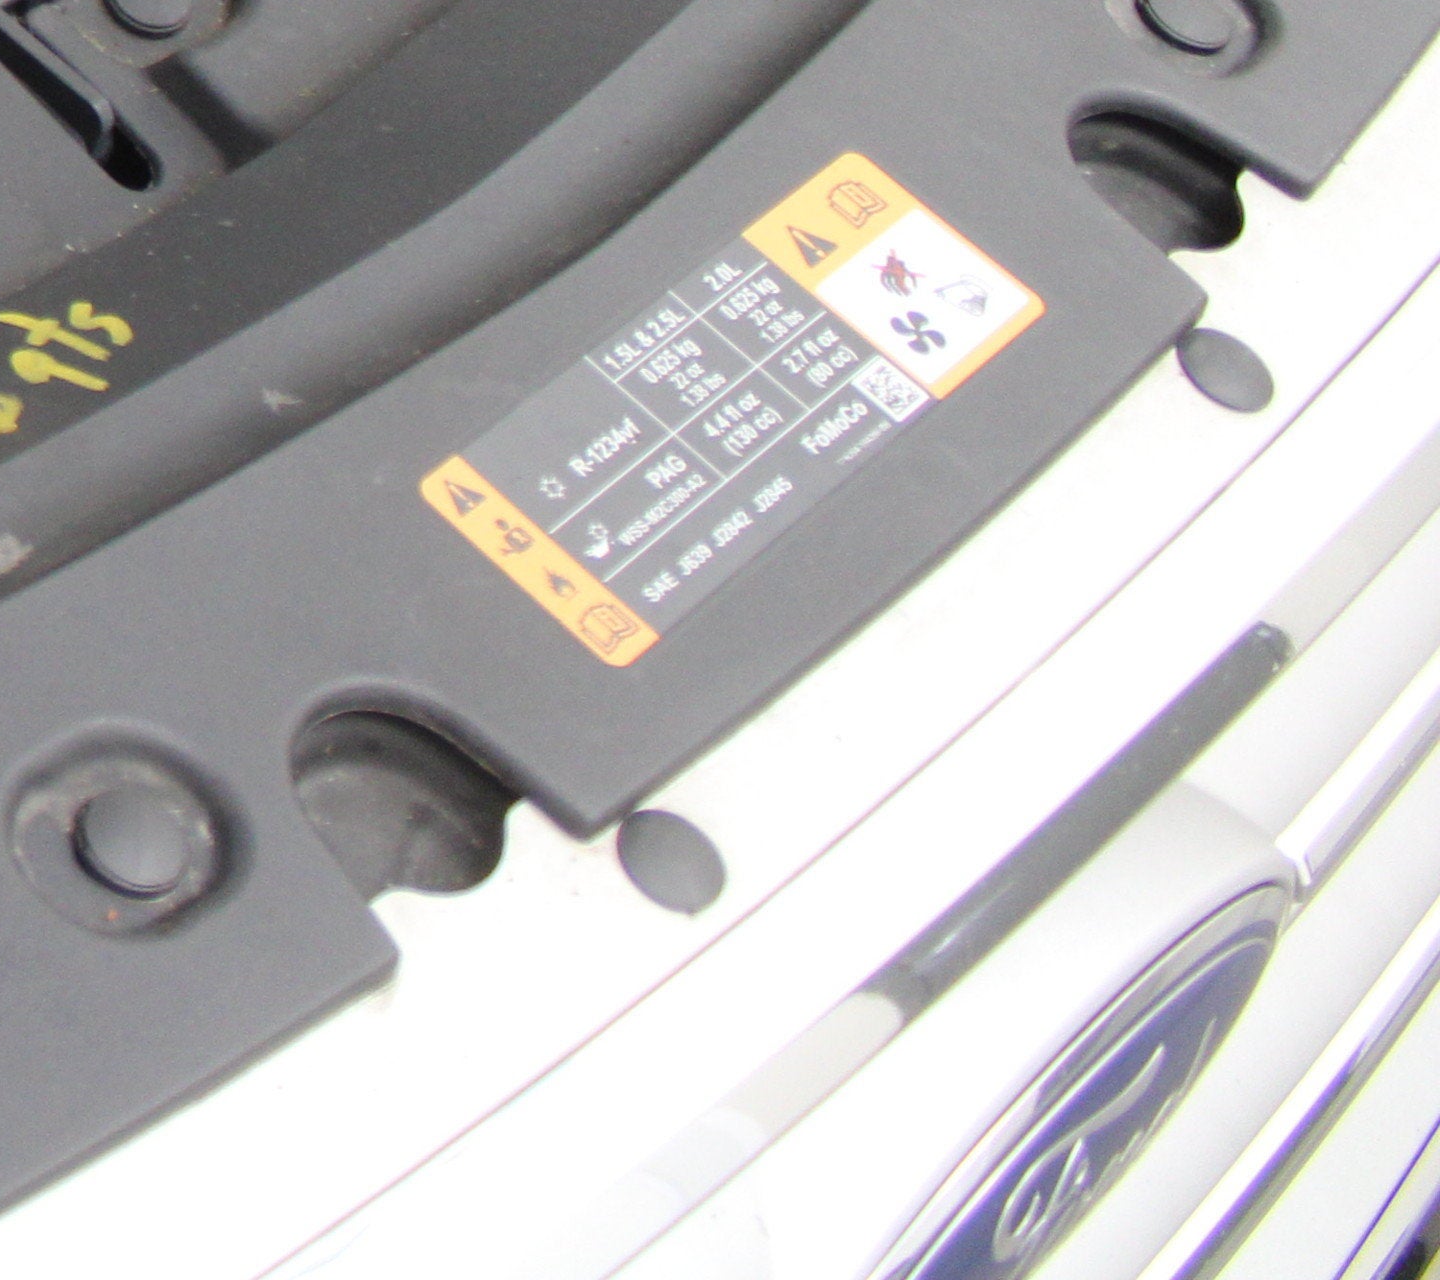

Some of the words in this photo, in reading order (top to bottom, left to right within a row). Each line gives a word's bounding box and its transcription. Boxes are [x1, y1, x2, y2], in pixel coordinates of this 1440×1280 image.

[703, 263, 743, 290] 2.0L
[750, 277, 780, 295] kg
[634, 330, 655, 347] &
[817, 329, 840, 347] oz
[672, 339, 702, 357] kg
[738, 392, 761, 411] oz
[800, 402, 868, 455] FoMoCo
[644, 455, 687, 489] PAG
[642, 572, 679, 603] SAE
